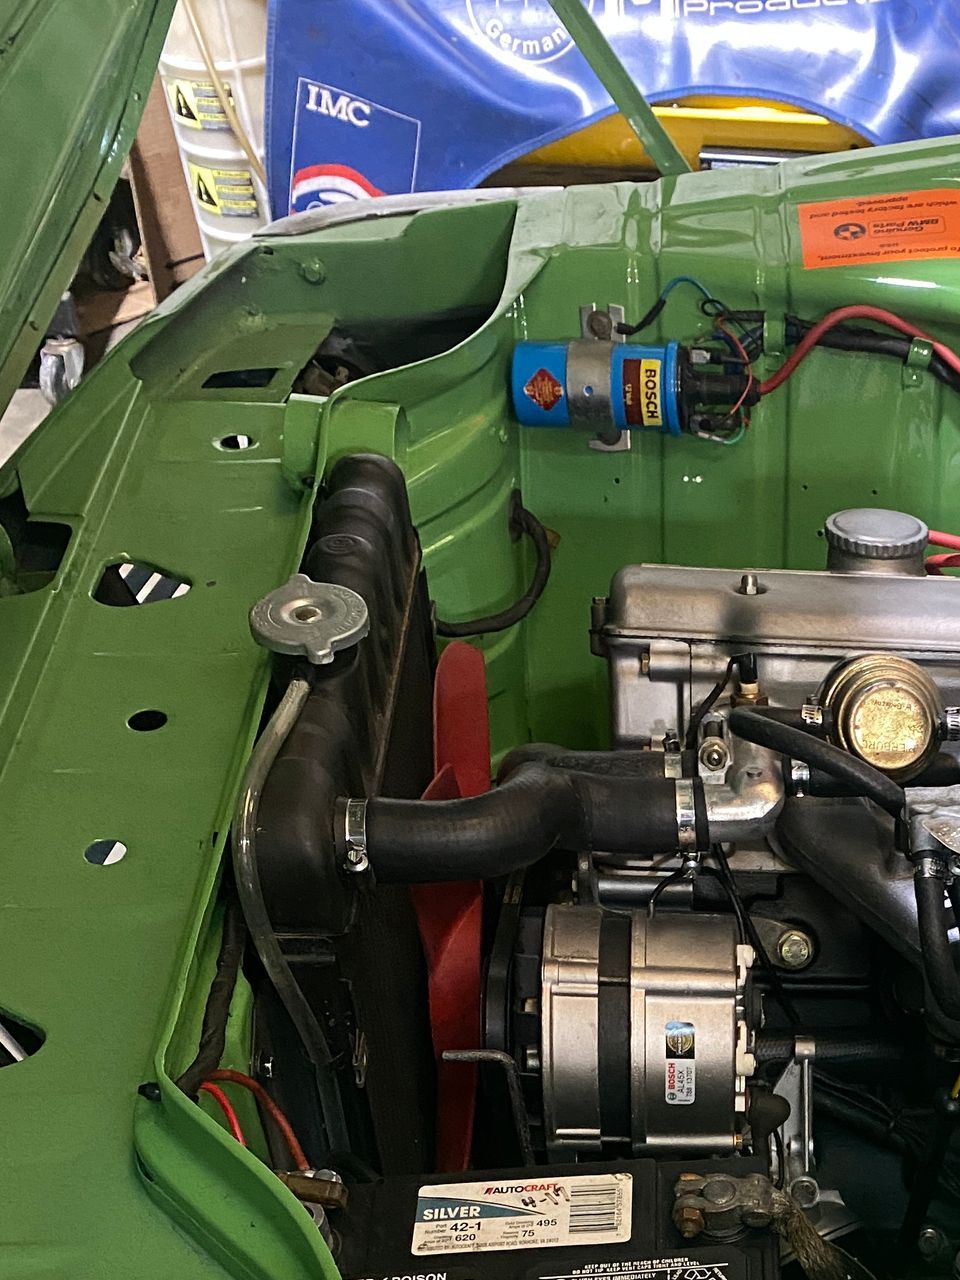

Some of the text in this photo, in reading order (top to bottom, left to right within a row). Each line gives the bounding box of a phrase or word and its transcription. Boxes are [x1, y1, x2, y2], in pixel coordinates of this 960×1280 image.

[485, 18, 568, 55] German
[305, 84, 371, 127] IMC
[873, 218, 939, 229] BMW Parts
[873, 226, 924, 234] Genuine
[645, 369, 659, 419] BOSCH
[667, 1062, 676, 1090] BOSCH
[493, 1183, 559, 1195] AUTOCRAFT
[422, 1205, 481, 1221] SILVER
[450, 1221, 481, 1232] 42-1
[536, 1218, 557, 1227] 495
[455, 1233, 476, 1242] 620
[521, 1229, 535, 1238] 75
